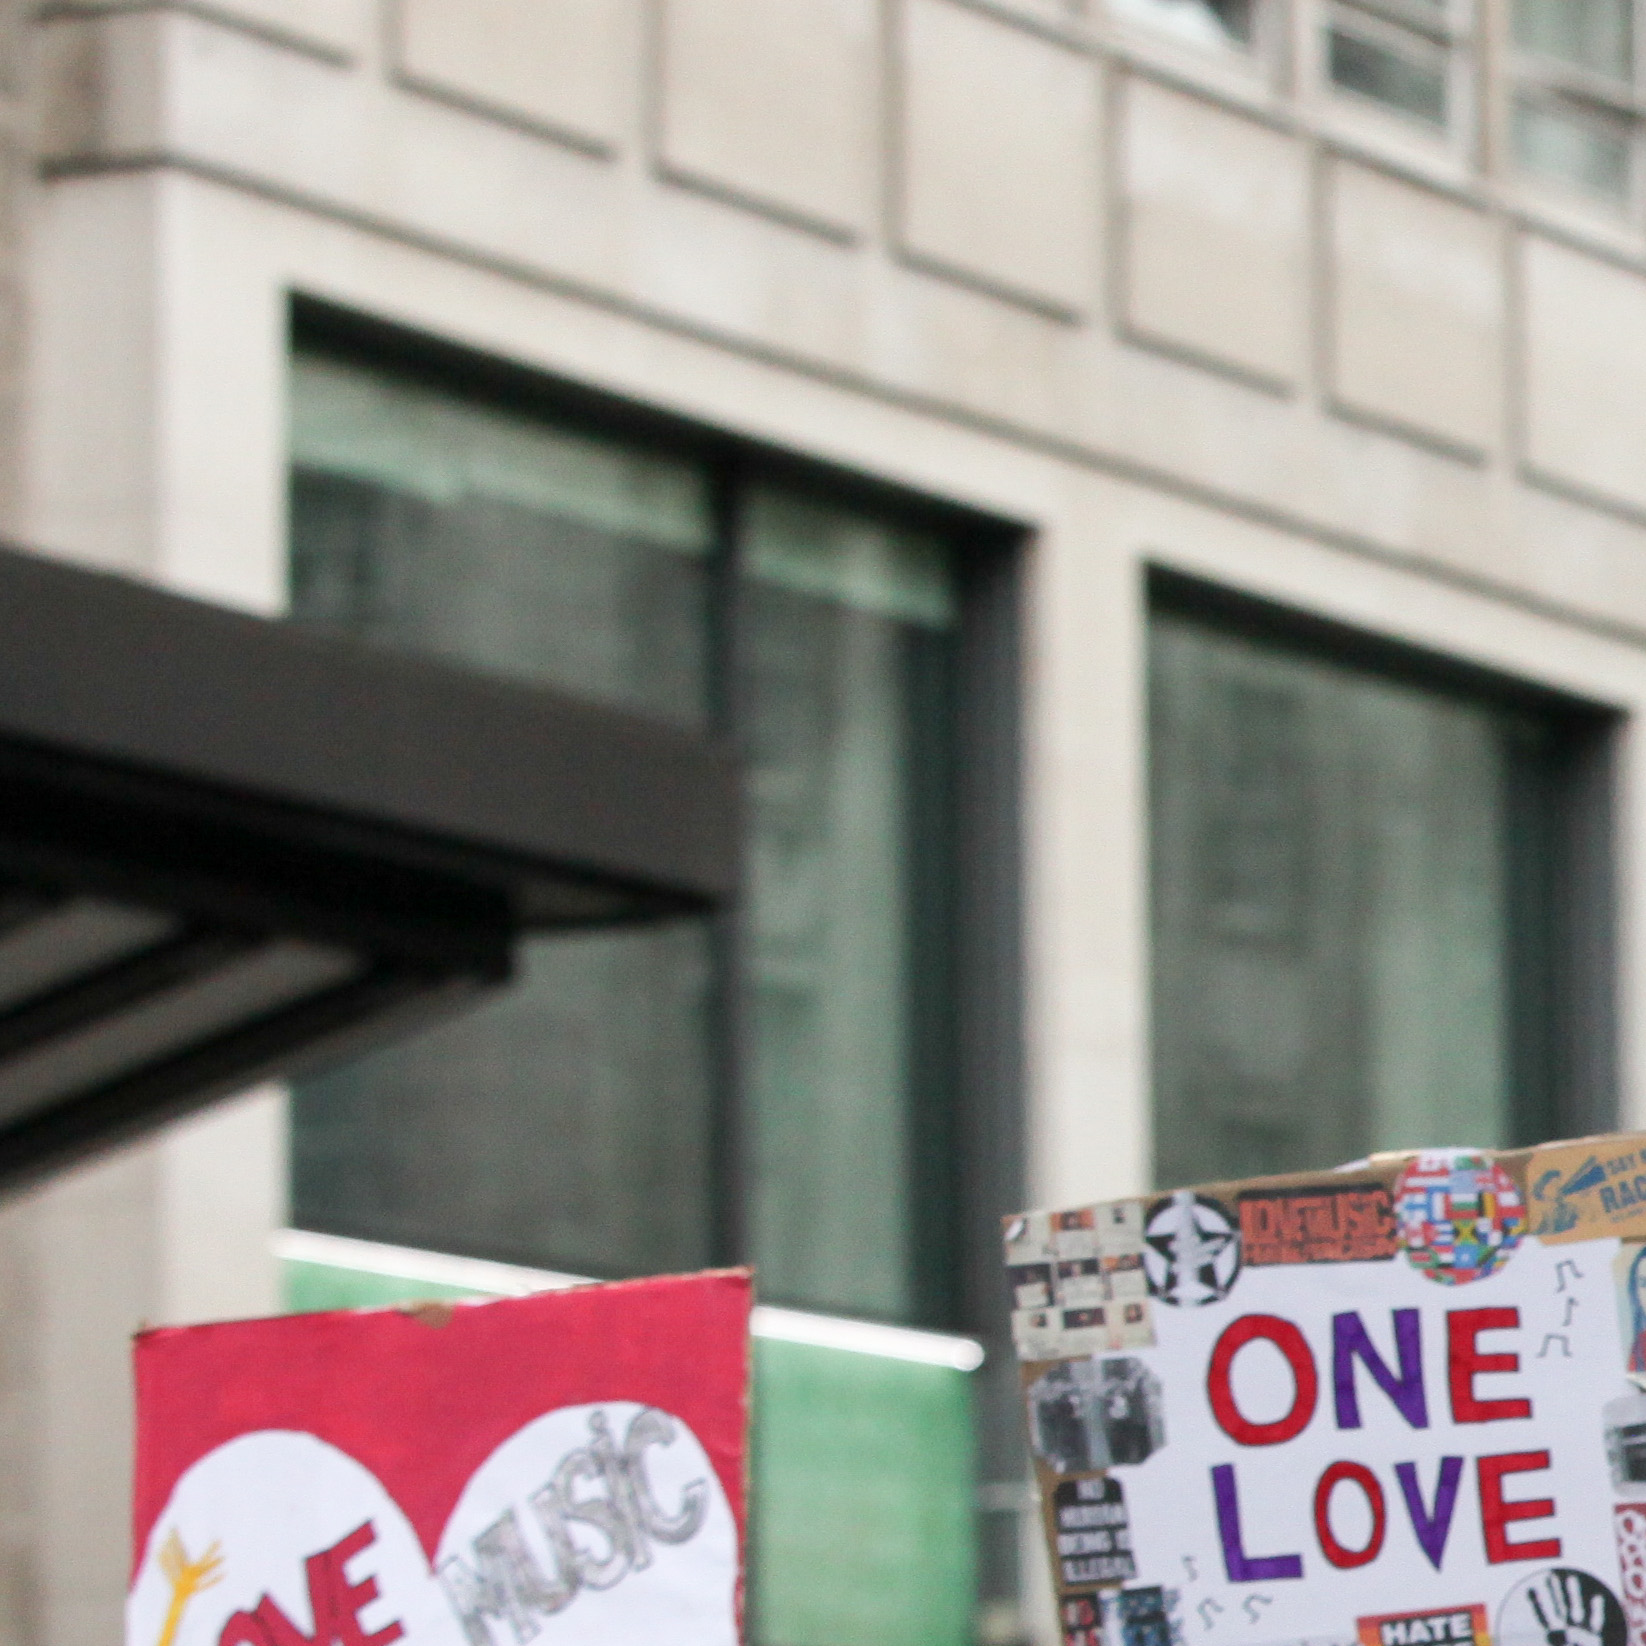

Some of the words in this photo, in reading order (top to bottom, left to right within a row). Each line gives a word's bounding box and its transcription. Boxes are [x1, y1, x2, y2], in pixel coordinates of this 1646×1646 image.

[1207, 1306, 1533, 1447] ONE
[1211, 1449, 1561, 1582] LOVE
[1382, 1612, 1472, 1646] HATE
